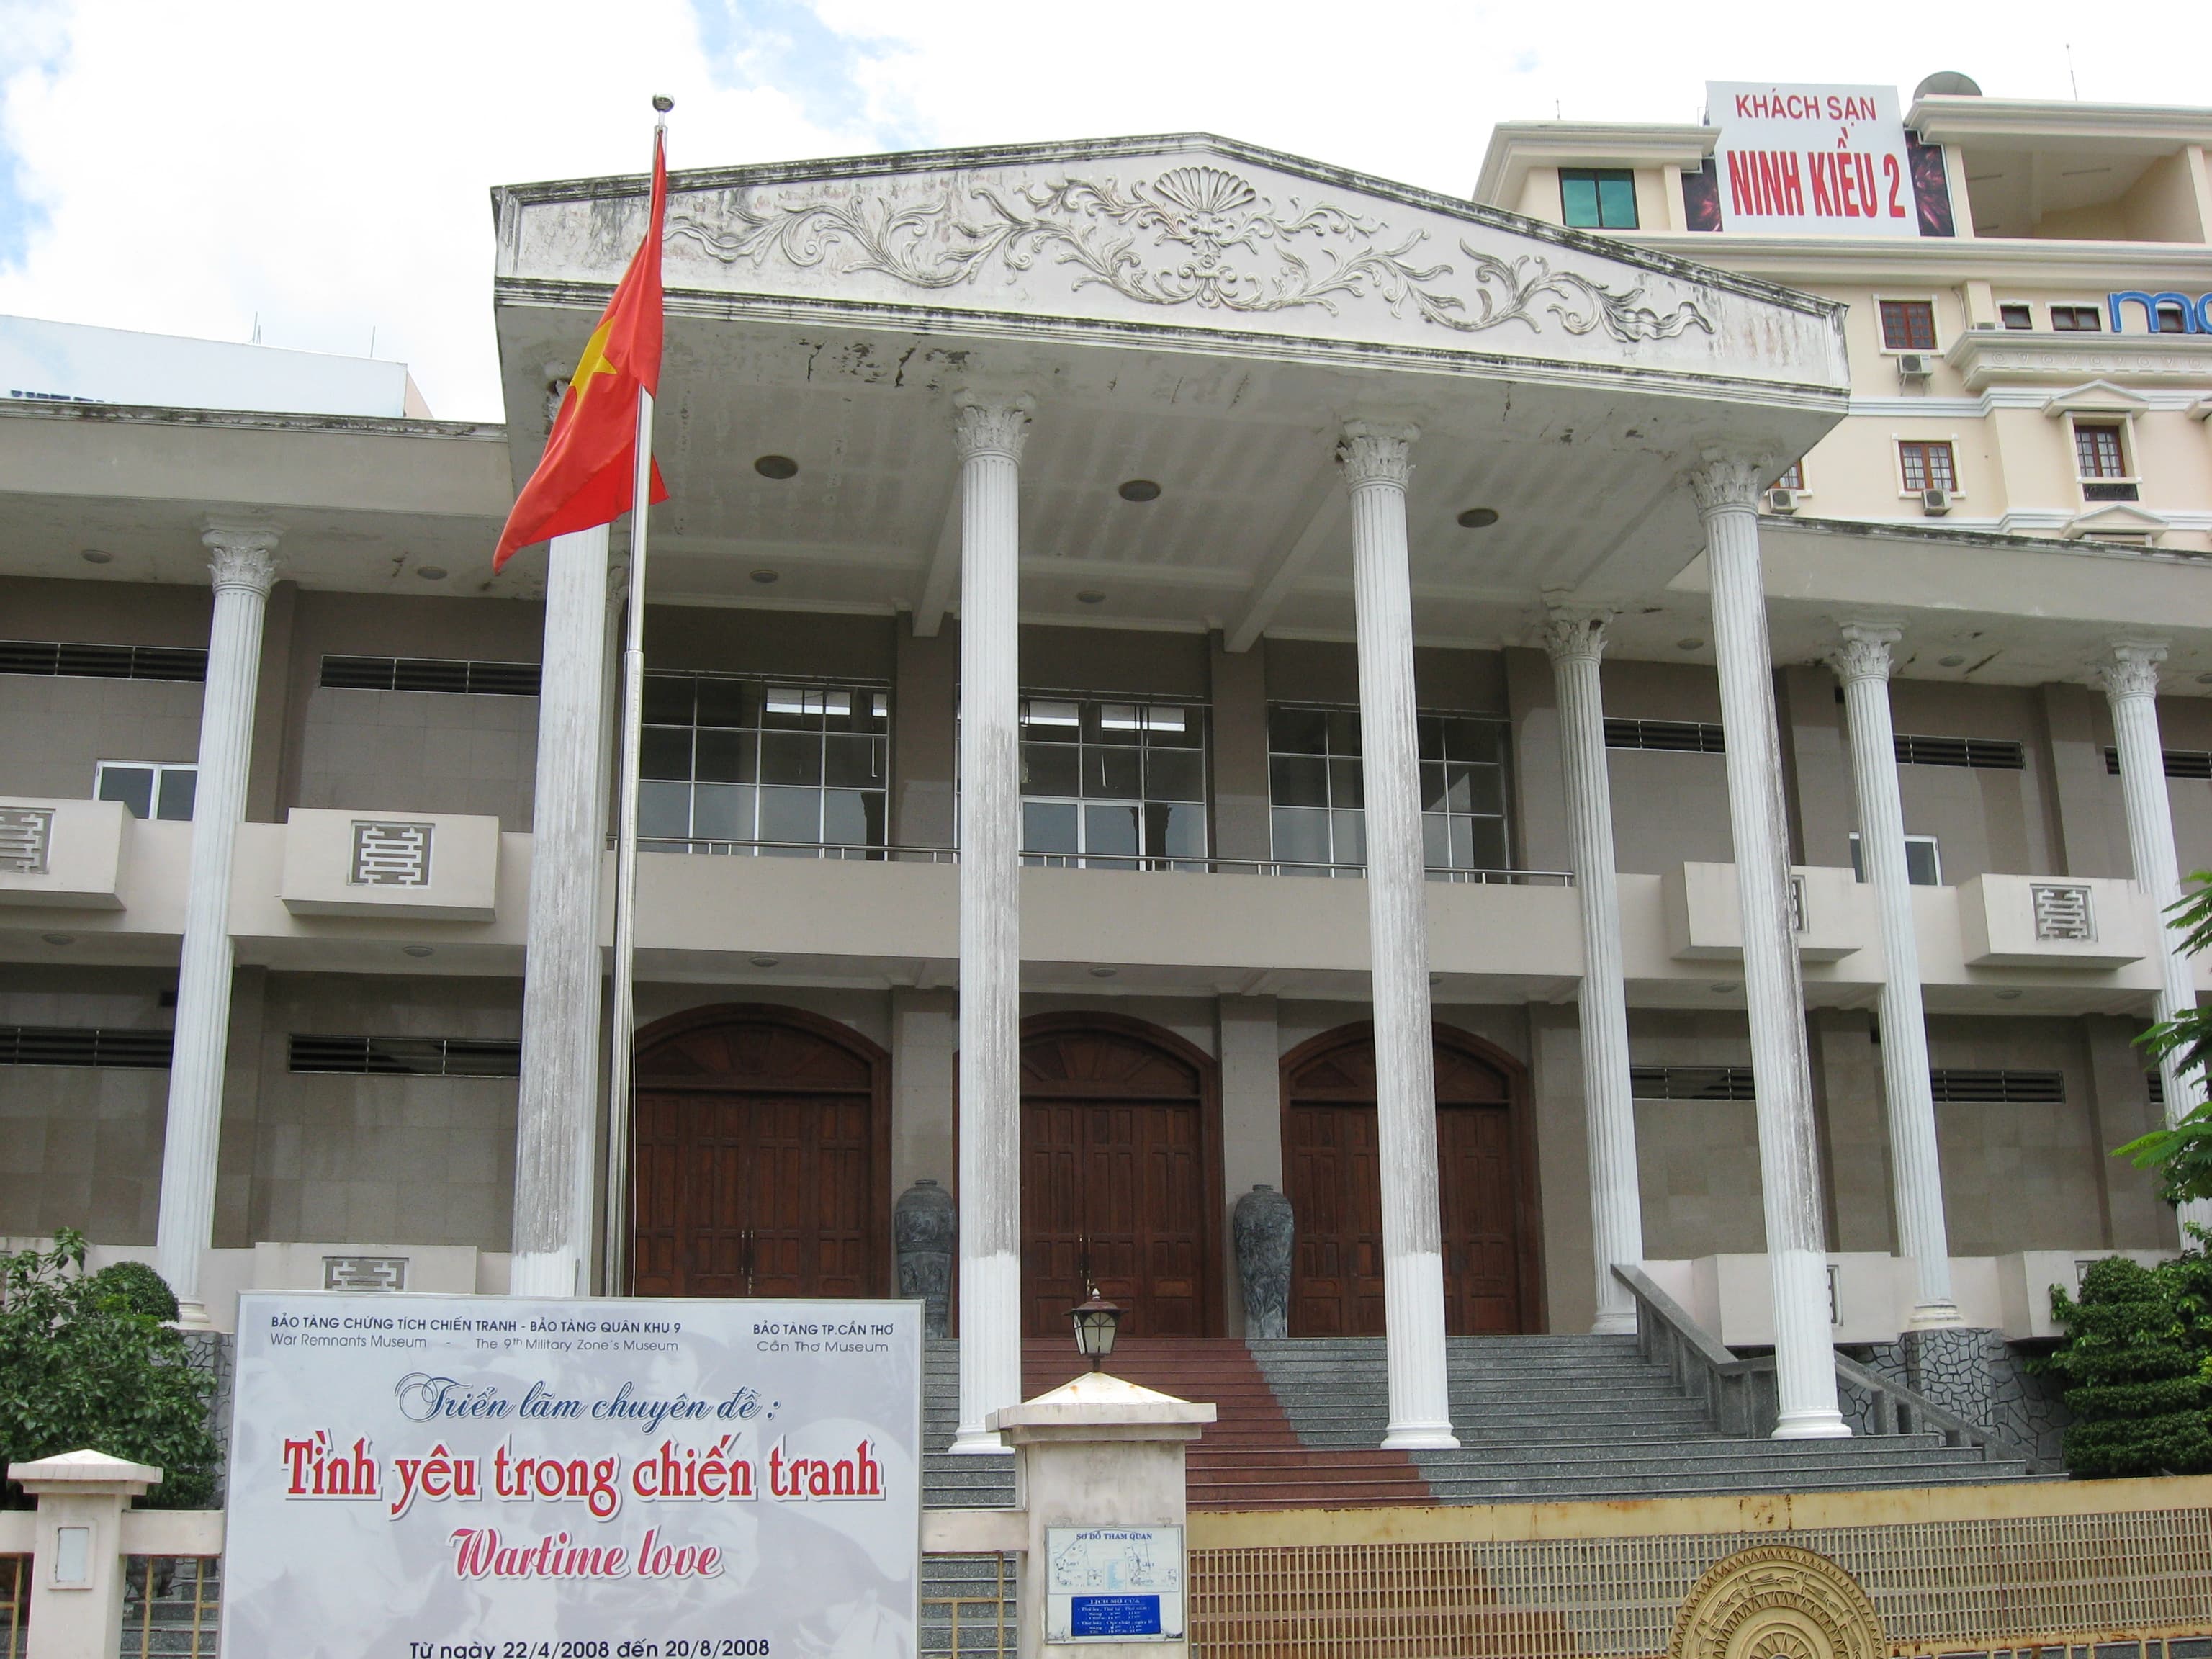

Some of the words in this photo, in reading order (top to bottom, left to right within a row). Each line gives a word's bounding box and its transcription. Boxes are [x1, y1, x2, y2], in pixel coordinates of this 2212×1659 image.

[1735, 88, 1820, 120] KHÁCH
[1828, 96, 1878, 127] SẠN
[1727, 150, 1805, 217] NINH
[1808, 126, 1879, 219] KIỀU
[1884, 153, 1907, 219] 2
[271, 1312, 300, 1328] BẢO
[303, 1314, 340, 1329] TÀNG
[343, 1315, 395, 1330] CHỨNG
[398, 1316, 426, 1331] TÍCH
[429, 1316, 472, 1331] CHIẾN
[475, 1320, 517, 1332] TRANH
[530, 1317, 557, 1333] BẢO
[561, 1319, 597, 1333] TÀNG
[601, 1319, 640, 1334] QUÂN
[644, 1322, 670, 1334] KHU
[673, 1322, 682, 1334] 9
[753, 1320, 780, 1335] BẢO
[783, 1322, 819, 1336] TÀNG
[870, 1323, 894, 1336] THƠ
[270, 1332, 297, 1346] War
[301, 1333, 367, 1348] Remnants
[370, 1334, 428, 1349] Museum
[475, 1338, 498, 1349] The
[525, 1338, 572, 1352] Military
[623, 1340, 679, 1352] Museum
[756, 1339, 790, 1352] Cần
[793, 1341, 821, 1352] Thơ
[824, 1341, 889, 1352] Museum
[395, 1372, 514, 1422] Triển
[518, 1380, 585, 1419] lãm
[590, 1380, 713, 1434] chuyên
[284, 1430, 377, 1496] Tình
[391, 1443, 476, 1515] yêu
[494, 1442, 616, 1517] trong
[632, 1434, 752, 1496] chiến
[768, 1439, 881, 1496] tranh
[451, 1527, 626, 1577] Wartime
[637, 1528, 720, 1577] love
[410, 1641, 434, 1659] Từ
[440, 1640, 496, 1659] ngày
[503, 1641, 610, 1659] 22/4/2008
[616, 1638, 658, 1658] đến
[665, 1640, 770, 1658] 20/8/2008
